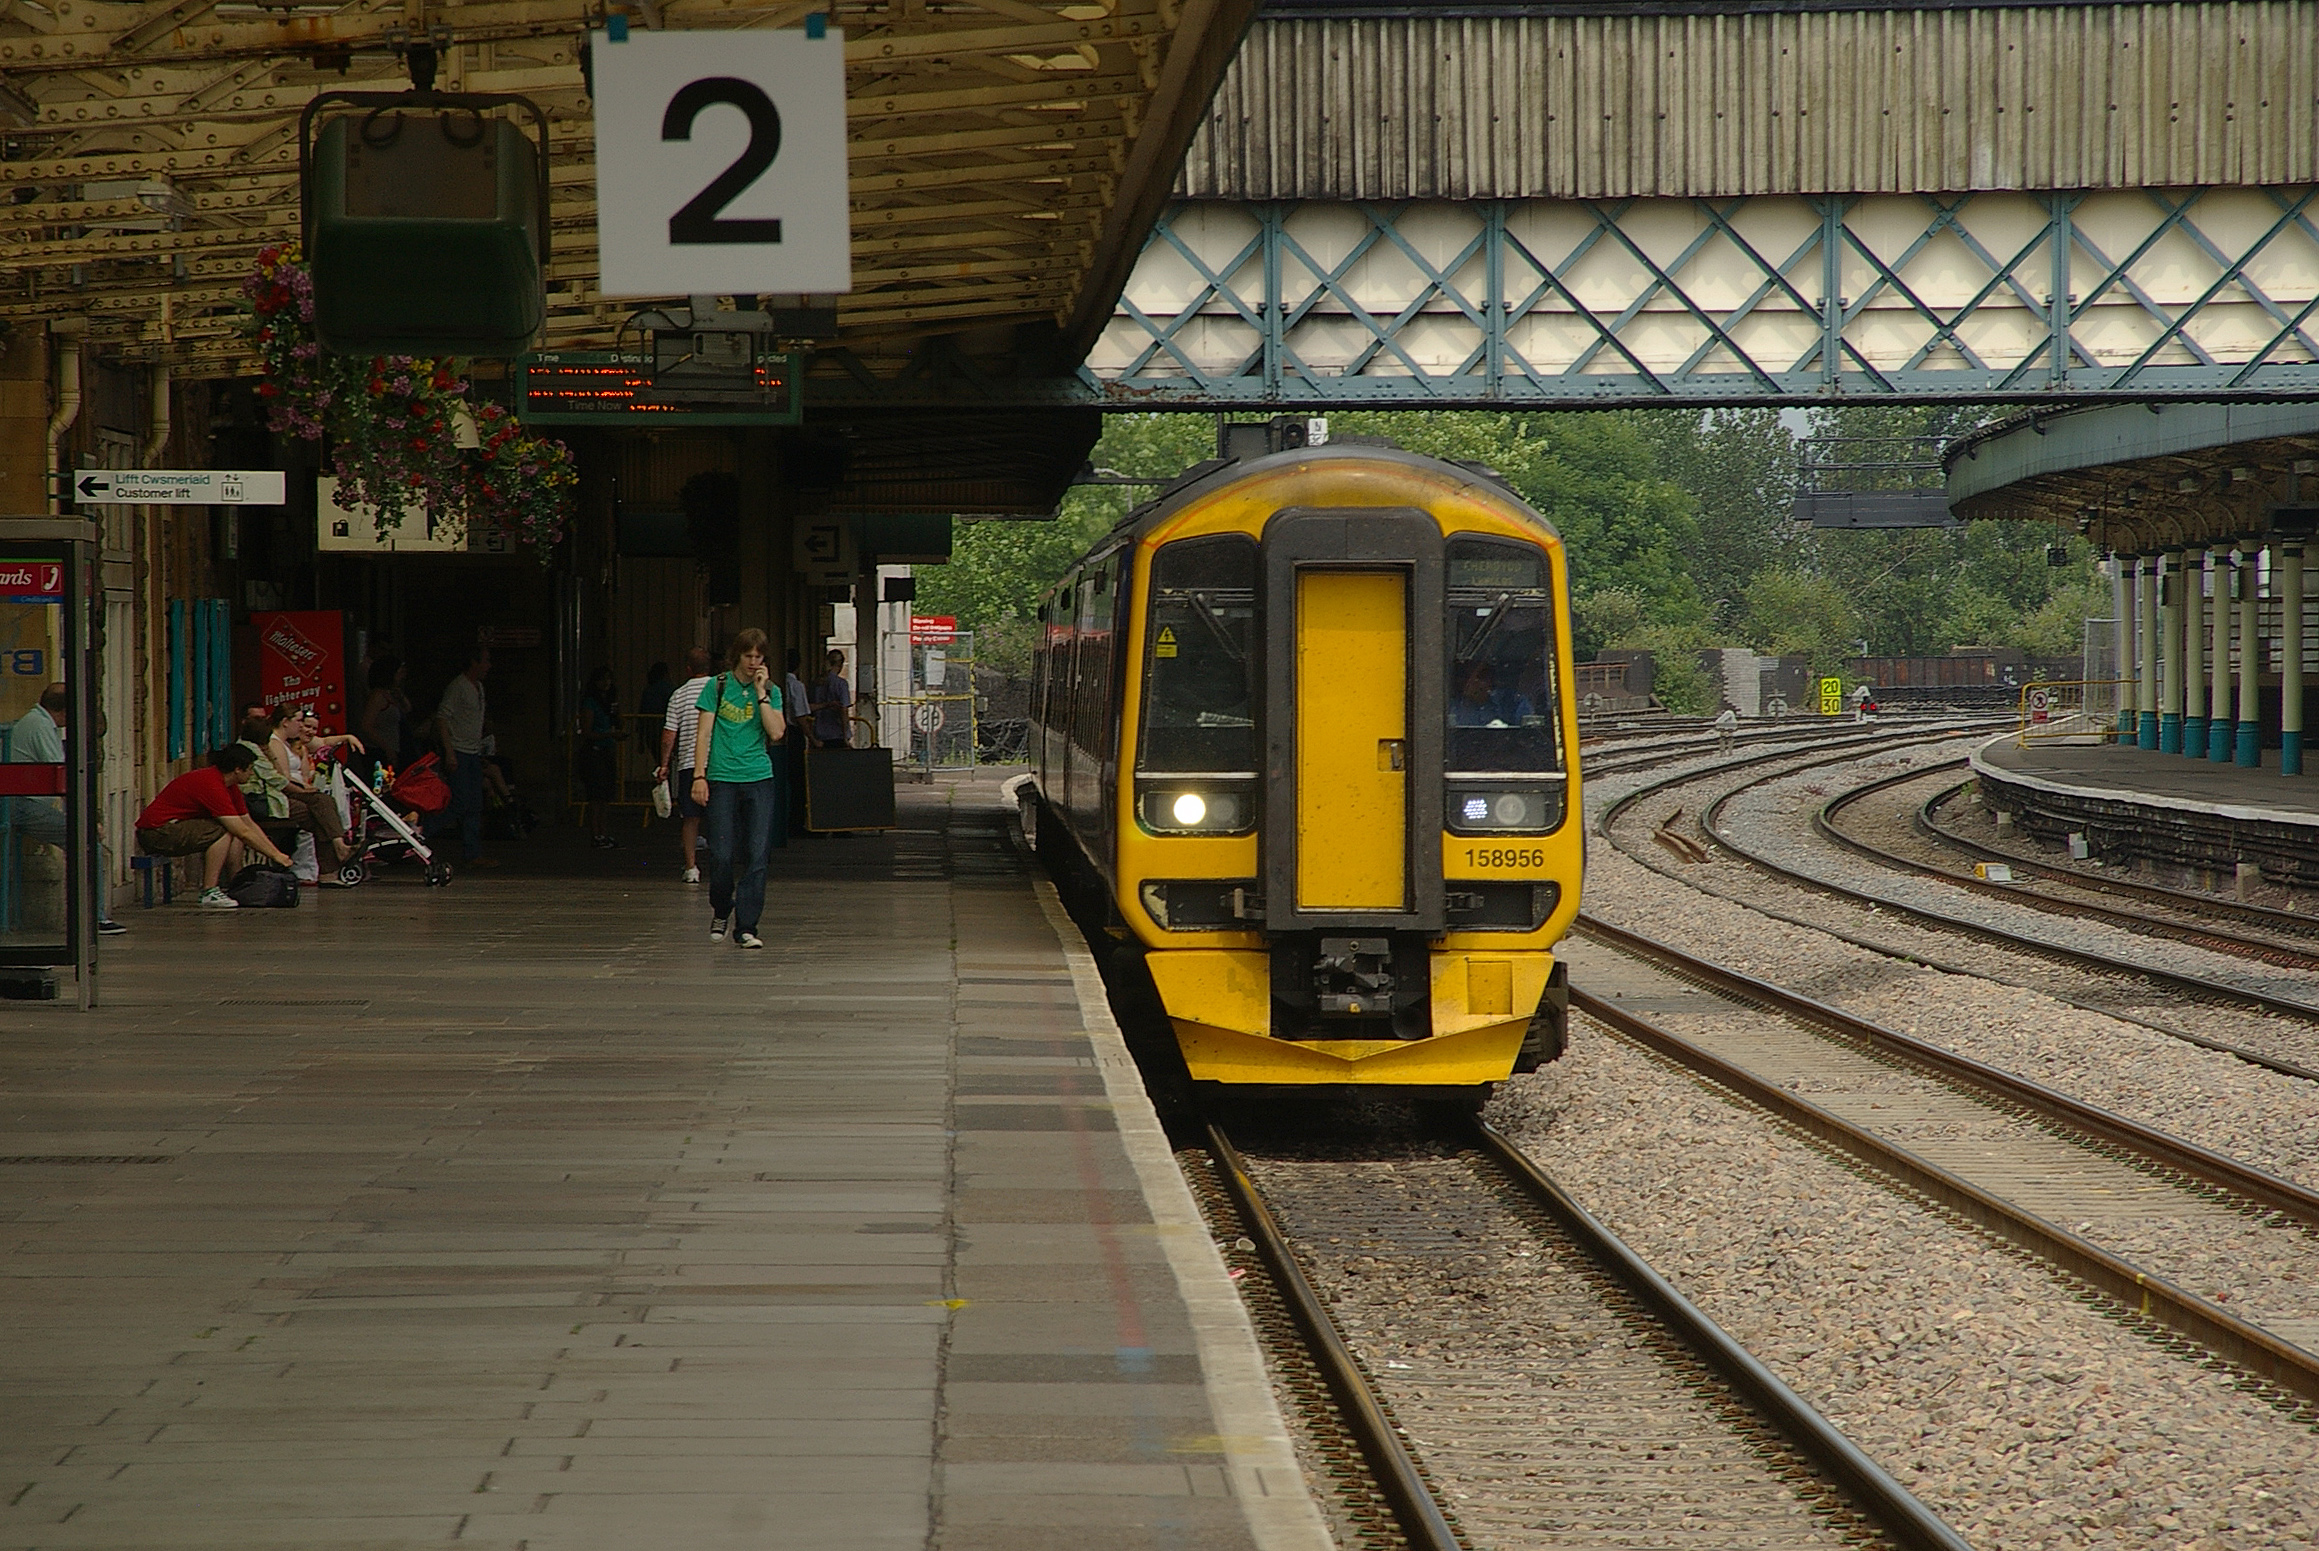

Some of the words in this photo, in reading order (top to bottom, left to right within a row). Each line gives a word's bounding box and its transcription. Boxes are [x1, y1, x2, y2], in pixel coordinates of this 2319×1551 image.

[662, 76, 782, 244] 2
[567, 400, 595, 411] Time
[597, 400, 622, 411] Now
[115, 474, 140, 484] Lifft
[141, 474, 211, 485] Cwsmeriaid
[115, 487, 174, 498] Customer
[175, 487, 191, 498] lift
[0, 568, 33, 586] ards
[268, 630, 318, 661] Maltesers
[1823, 680, 1839, 694] 20
[265, 690, 300, 707] lighter
[301, 686, 321, 698] way
[1823, 698, 1840, 713] 30
[1465, 848, 1544, 868] 158956
